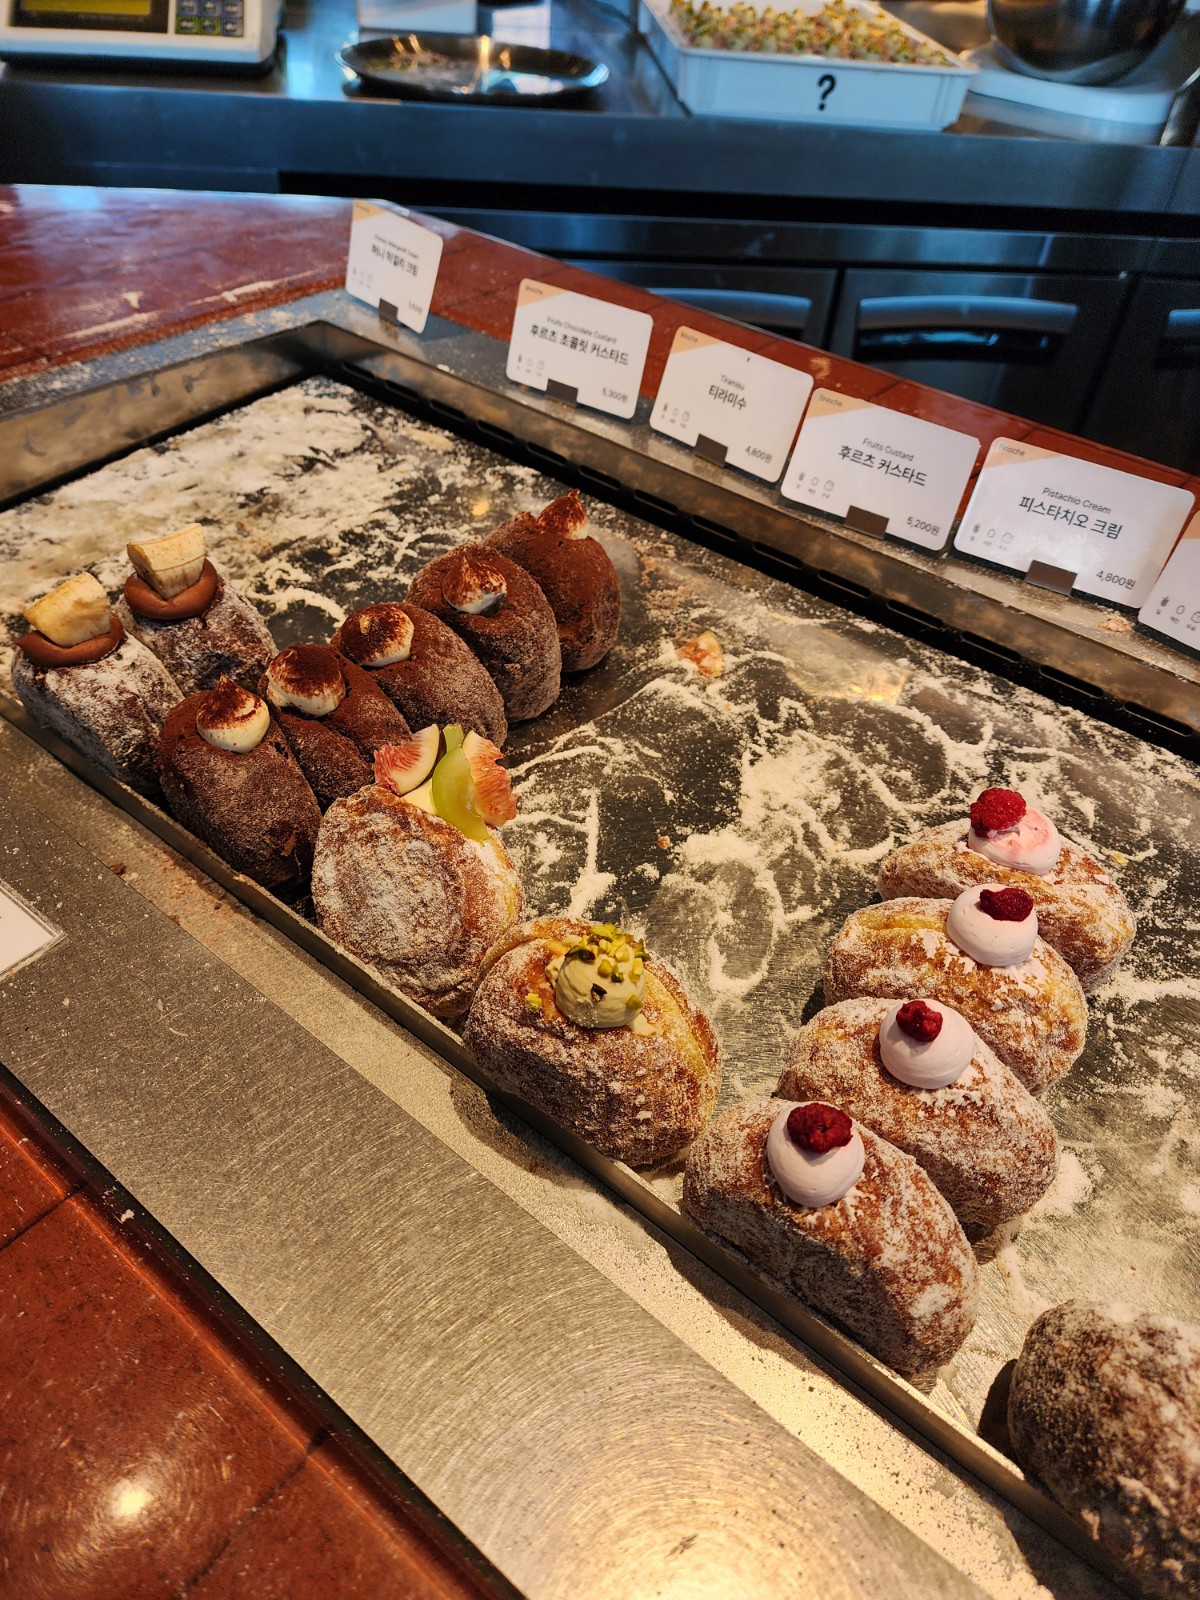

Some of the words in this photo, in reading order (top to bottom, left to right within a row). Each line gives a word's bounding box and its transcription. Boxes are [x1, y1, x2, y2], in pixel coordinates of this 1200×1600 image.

[564, 321, 593, 336] Chocolate
[593, 330, 617, 344] Custard
[530, 324, 557, 343] 후르츠
[560, 333, 589, 353] 초콜릿
[590, 343, 629, 366] 커스타드
[720, 374, 745, 391] Tiramisu
[708, 385, 747, 411] 티라미수
[745, 446, 773, 464] 4,800원
[862, 438, 883, 452] Fruits
[884, 445, 914, 462] Custard
[838, 445, 875, 468] 후르츠
[878, 458, 928, 486] 커스타드
[1042, 487, 1081, 506] Pistachio
[1082, 499, 1112, 515] Cream
[906, 517, 940, 537] 5,200원
[1018, 496, 1089, 529] 피스타치오
[1091, 518, 1123, 540] 크림
[1096, 570, 1136, 590] 4,800원
